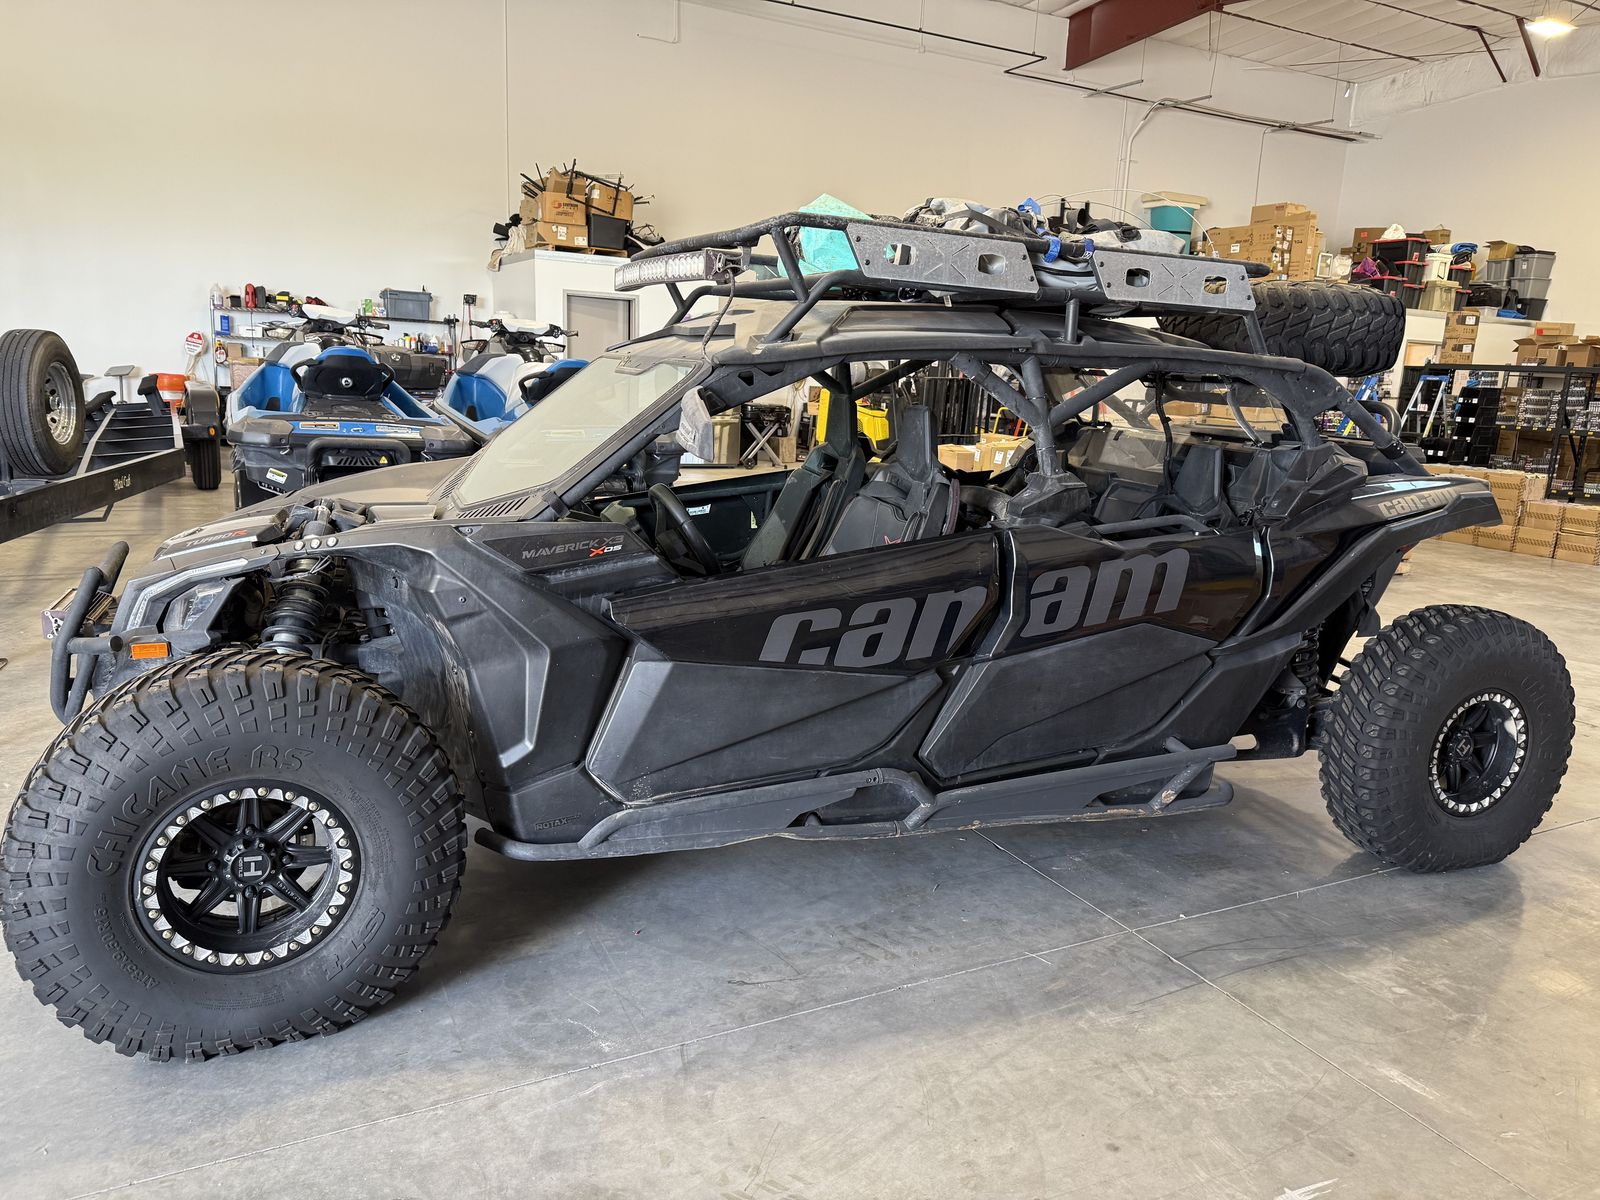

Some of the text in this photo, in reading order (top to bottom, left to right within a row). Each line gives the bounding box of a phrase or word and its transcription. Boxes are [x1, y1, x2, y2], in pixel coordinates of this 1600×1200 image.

[521, 535, 625, 560] MAVERICK X3
[86, 744, 314, 878] CHICANE RS
[535, 816, 568, 831] ROTAX
